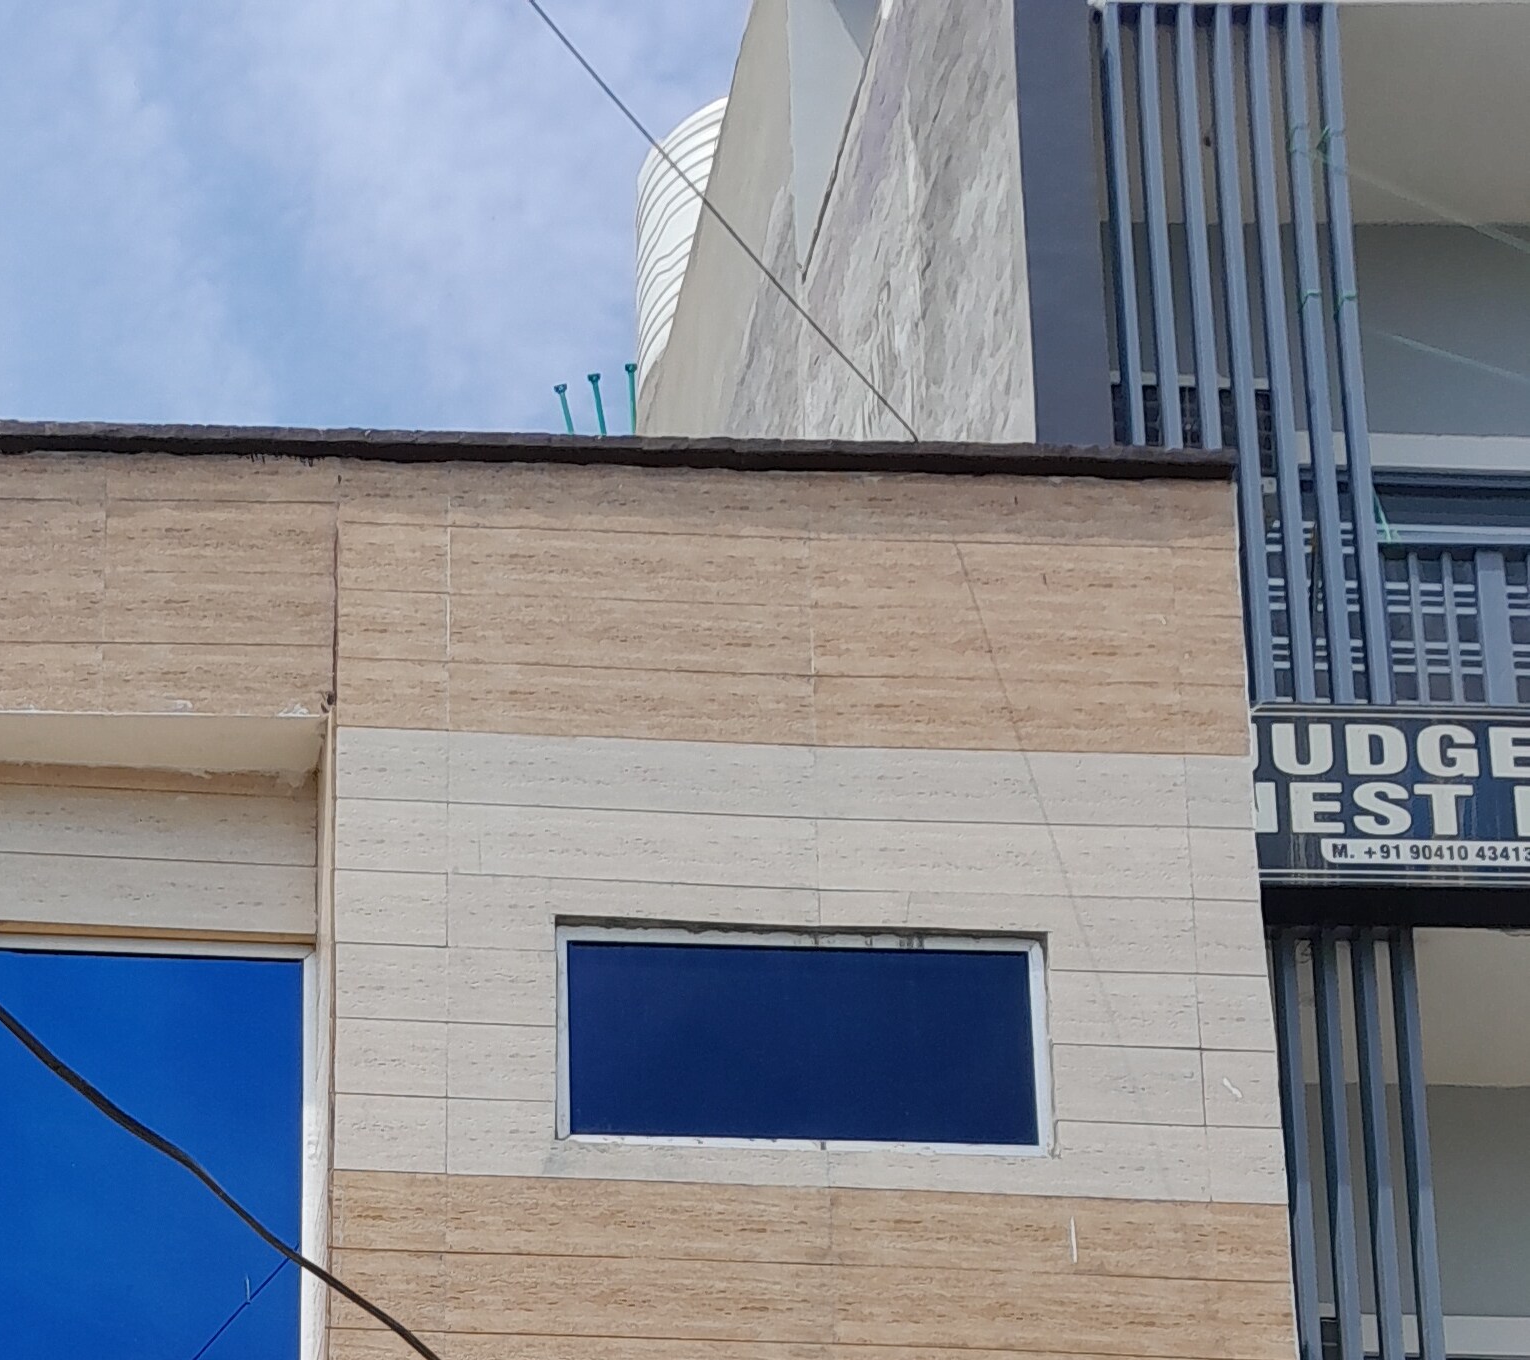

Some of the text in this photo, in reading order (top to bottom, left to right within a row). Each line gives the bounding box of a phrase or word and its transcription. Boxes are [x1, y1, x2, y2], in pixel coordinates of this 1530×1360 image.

[1252, 723, 1530, 778] UDGE
[1364, 844, 1402, 860] +91
[1409, 844, 1469, 861] 90410
